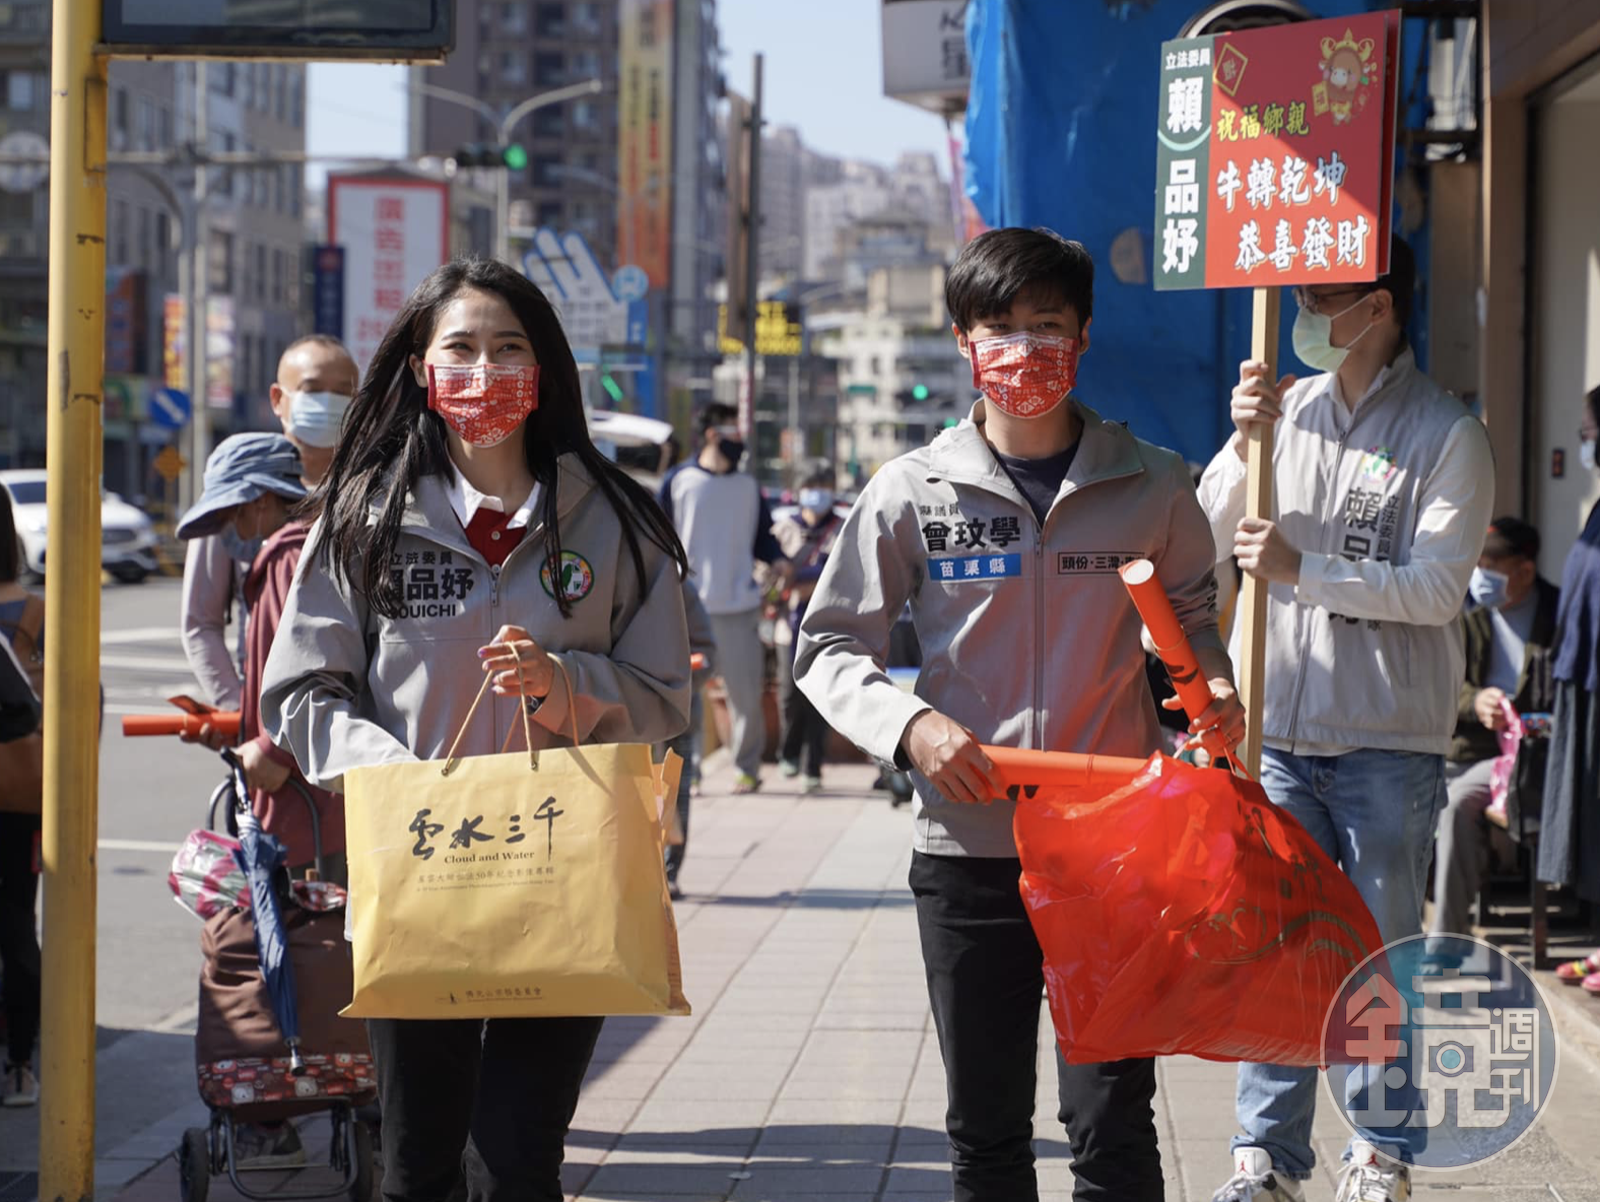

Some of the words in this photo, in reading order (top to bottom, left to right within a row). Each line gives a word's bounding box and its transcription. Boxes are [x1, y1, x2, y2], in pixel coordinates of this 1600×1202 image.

[1165, 48, 1211, 70] 立法委員
[1216, 101, 1309, 142] 祝福鄉親
[1162, 77, 1204, 274] 賴品妤
[1216, 151, 1347, 211] 牛轉乾坤
[1234, 215, 1370, 274] 恭喜發財
[922, 516, 1021, 552] 曾玟學
[940, 558, 1006, 578] 苗栗縣
[1062, 556, 1139, 570] 頭份·三灣·
[393, 604, 456, 619] OUICHI
[409, 796, 564, 862] 雲水三千
[444, 853, 475, 864] Cloud
[479, 853, 499, 862] and
[503, 851, 535, 861] Water
